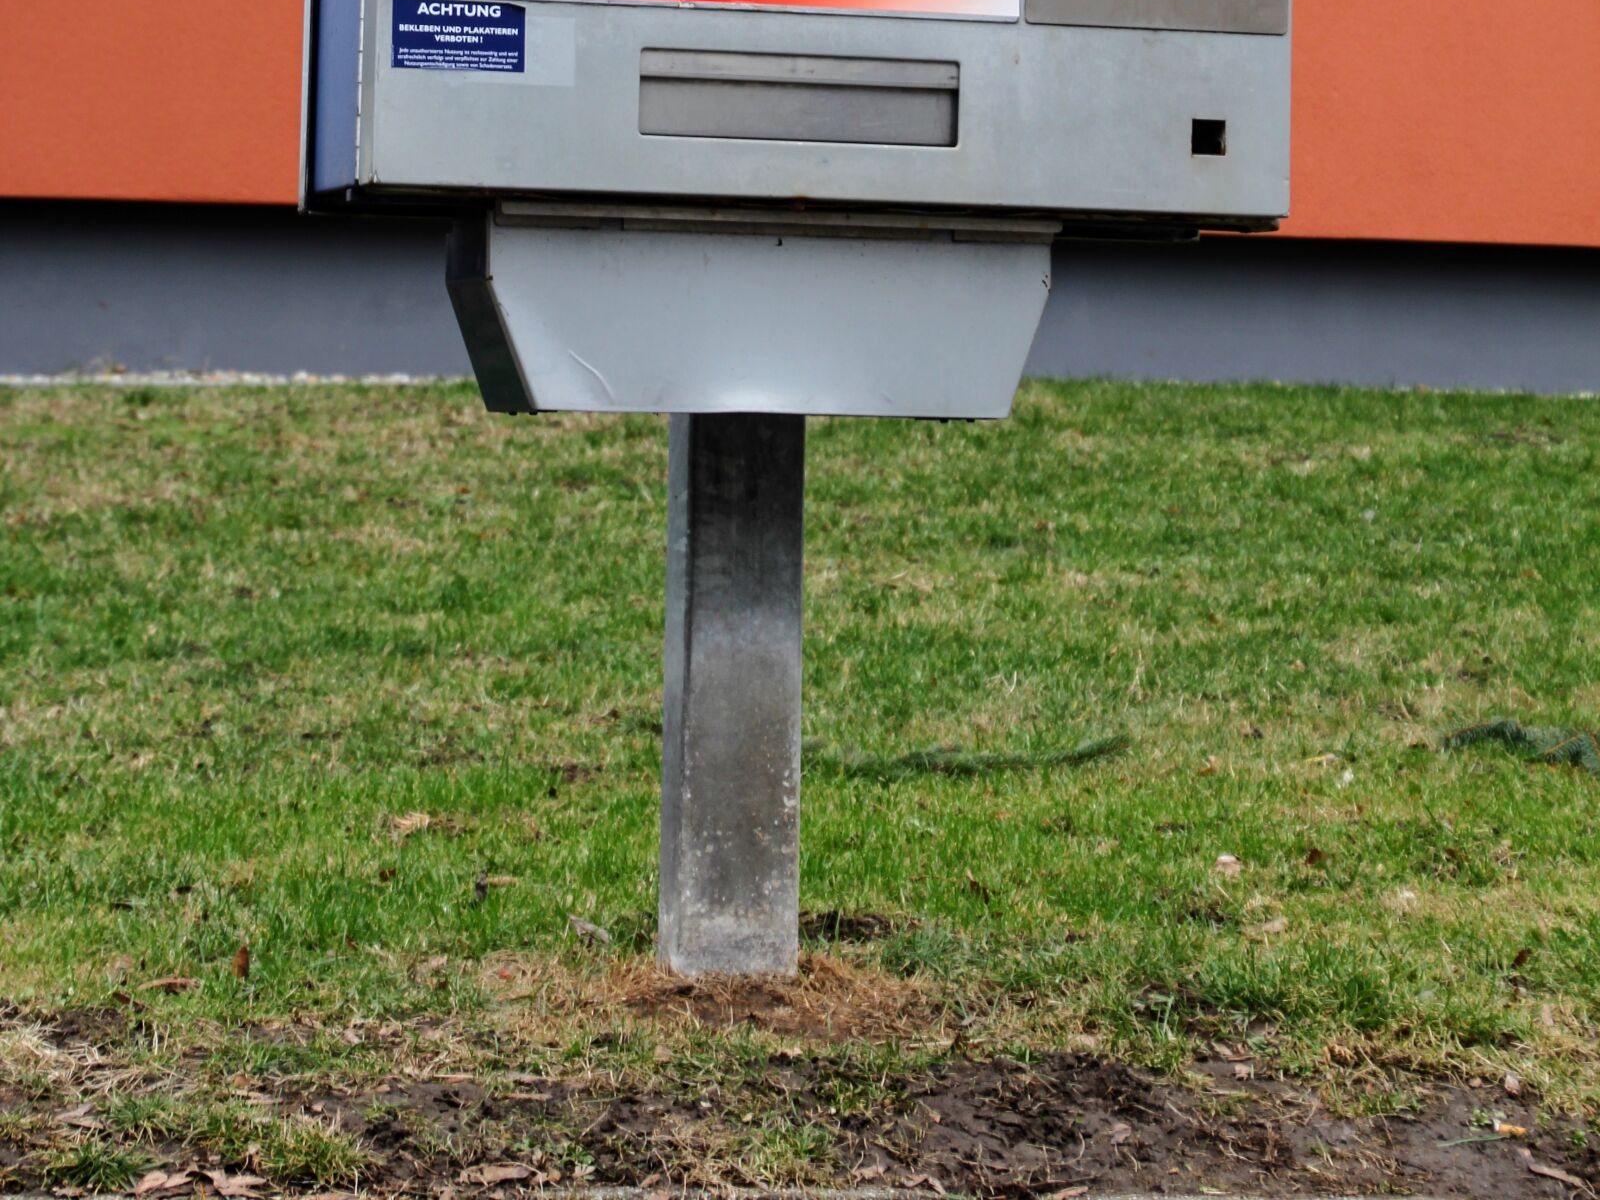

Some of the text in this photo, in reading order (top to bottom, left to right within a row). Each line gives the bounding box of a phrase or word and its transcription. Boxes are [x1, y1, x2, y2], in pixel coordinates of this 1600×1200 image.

[417, 2, 501, 18] ACHTUNG
[399, 24, 518, 36] BEKLEBEN UND PLAKATIEREN
[434, 35, 478, 43] VERBOTEN
